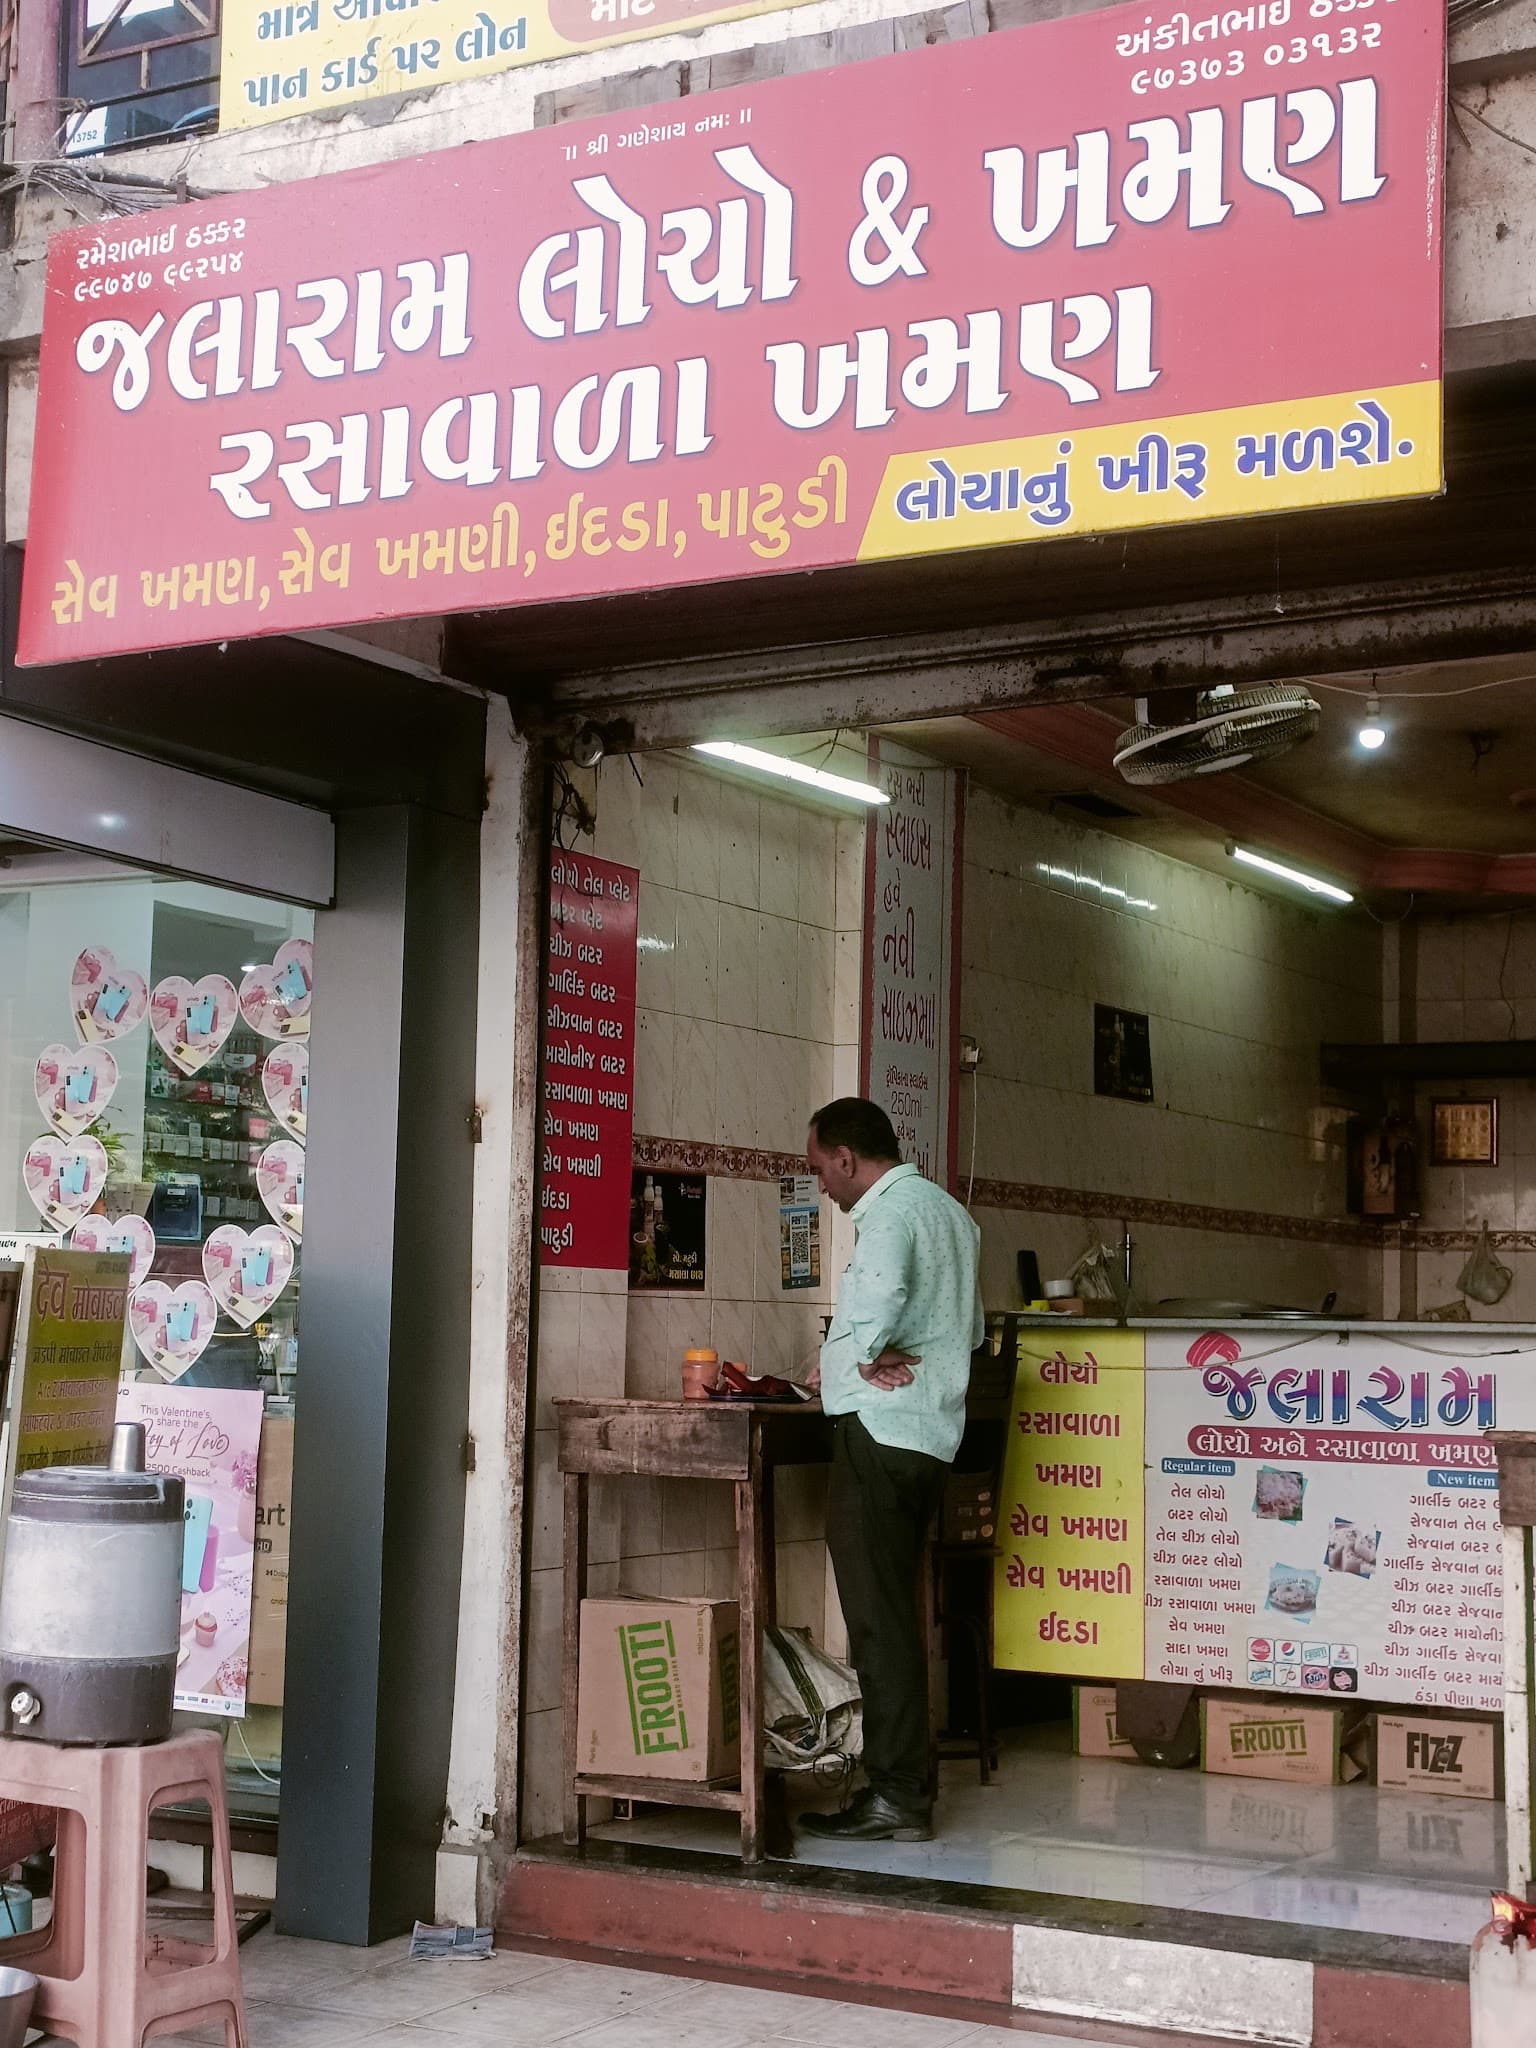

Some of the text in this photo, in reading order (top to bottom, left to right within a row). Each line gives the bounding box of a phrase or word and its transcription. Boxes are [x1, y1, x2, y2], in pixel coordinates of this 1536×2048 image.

[243, 13, 527, 107] પાન કાર્ડ પર લોન
[1130, 22, 1382, 94] ૯૭૩૭૩ ૦૩૧૩૨
[586, 134, 609, 157] શ્રી
[617, 124, 686, 148] ગણેશાય
[74, 77, 1388, 412] જલારામ લોચો & ખમણ
[76, 218, 246, 270] રમેશભાઈ ઠક્કર
[74, 251, 244, 301] ૯૯૭૪૭ ૯૯૨૫૪
[210, 284, 1161, 521] રસાવાળા ખમણ
[894, 440, 1078, 526] લોચાનું
[1236, 401, 1415, 481] મળશે.
[51, 558, 117, 626] સેવ
[277, 526, 352, 597] સેવ
[695, 454, 850, 559] પાટુડી
[577, 943, 603, 965] બટર
[883, 906, 916, 980] નવી
[591, 982, 616, 1003] બટર
[598, 1018, 623, 1039] બટર
[600, 1055, 626, 1075] બટર
[545, 1081, 628, 1111] રસાવાળા ખમણ
[544, 1110, 599, 1142] સેવ ખમણ
[543, 1146, 602, 1178] સેવ ખમણી
[37, 1256, 70, 1322] देव
[1040, 1351, 1098, 1384] લોચો
[141, 1405, 158, 1415] This
[1202, 1364, 1496, 1431] જલારામ
[157, 1417, 198, 1428] share the
[1017, 1412, 1120, 1437] રસાવાળા
[170, 1429, 184, 1455] of
[186, 1422, 229, 1459] Love
[1196, 1428, 1252, 1455] લોચો
[1260, 1431, 1309, 1458] અને
[1316, 1437, 1421, 1463] રસાવાળા
[172, 1466, 210, 1476] Cashback
[1036, 1463, 1101, 1488] ખમણ
[1163, 1459, 1232, 1473] Regular item
[1437, 1473, 1496, 1487] New item
[256, 1504, 285, 1526] art
[1458, 1497, 1487, 1510] બટર
[1009, 1503, 1128, 1542] સેવ ખમણ
[1410, 1512, 1458, 1530] સેજવાન
[1464, 1515, 1486, 1531] તેલ
[1407, 1534, 1455, 1551] સેજવાન
[1461, 1541, 1489, 1553] બટર
[1006, 1554, 1132, 1594] સેવ ખમણી
[1431, 1557, 1479, 1575] સેજવાન
[1394, 1578, 1419, 1593] ચીઝ
[1425, 1583, 1454, 1595] બટર
[1391, 1599, 1416, 1614] ચીઝ
[1423, 1604, 1451, 1616] બટર
[1039, 1611, 1098, 1645] ઈદડા
[1419, 1626, 1448, 1638] બટર
[1384, 1642, 1409, 1656] ચીઝ
[1465, 1650, 1501, 1664] સેજવા
[626, 1621, 680, 1754] FROOTI
[1364, 1663, 1389, 1677] ચીઝ
[1444, 1672, 1472, 1684] બટર
[1444, 1690, 1473, 1706] પીણા
[1229, 1725, 1307, 1754] FROOTI
[1406, 1731, 1464, 1773] FIZZ
